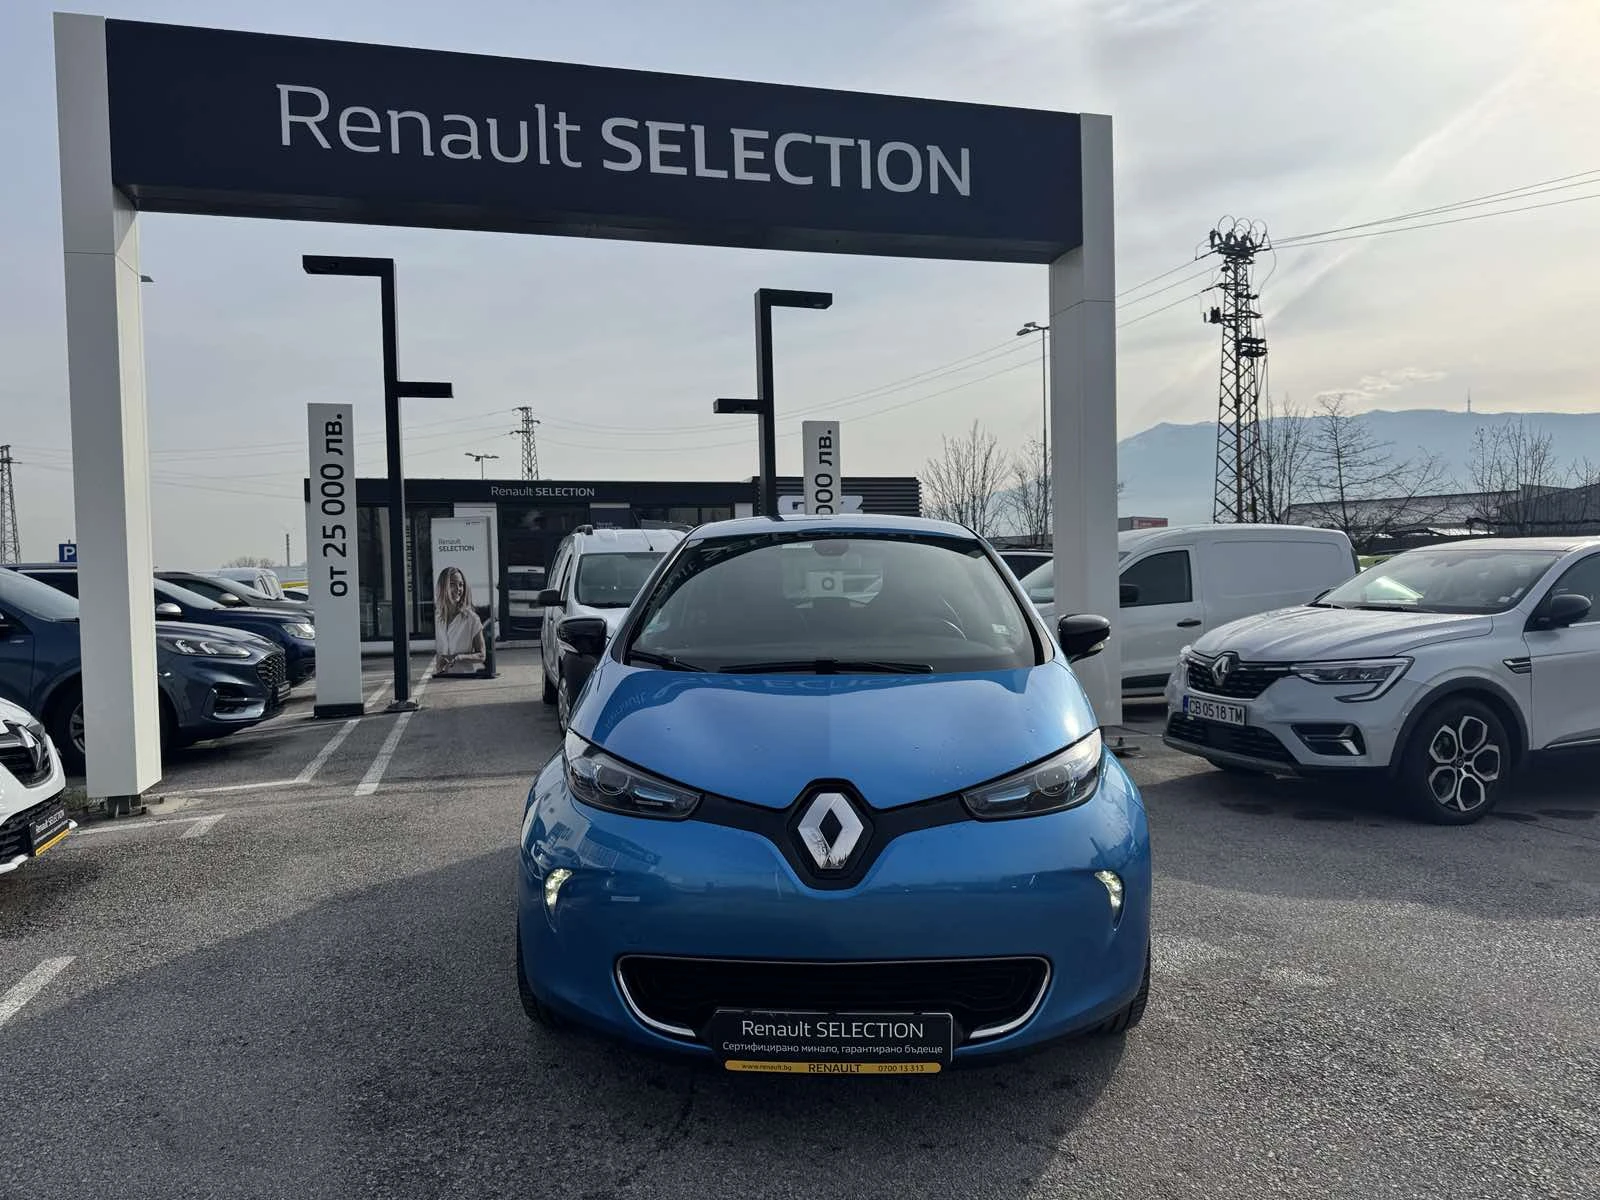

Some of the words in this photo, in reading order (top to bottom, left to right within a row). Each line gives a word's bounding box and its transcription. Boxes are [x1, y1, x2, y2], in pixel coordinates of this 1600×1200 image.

[276, 83, 582, 168] Renault
[602, 117, 971, 197] SELECTION
[320, 463, 345, 516] 000
[491, 487, 533, 497] Renault
[535, 488, 595, 497] SELECTION
[323, 524, 346, 557] 25
[63, 546, 76, 561] P
[1203, 702, 1227, 720] 0518
[1228, 707, 1243, 723] TM
[742, 1020, 811, 1037] Renault
[816, 1022, 924, 1038] SELECTION
[722, 1041, 799, 1053] Сертифицирано
[801, 1045, 839, 1054] минало,
[841, 1045, 903, 1055] гарантирано
[904, 1044, 943, 1055] бъдеще
[741, 1063, 792, 1071] www.renault.bg
[808, 1063, 860, 1073] RENAULT
